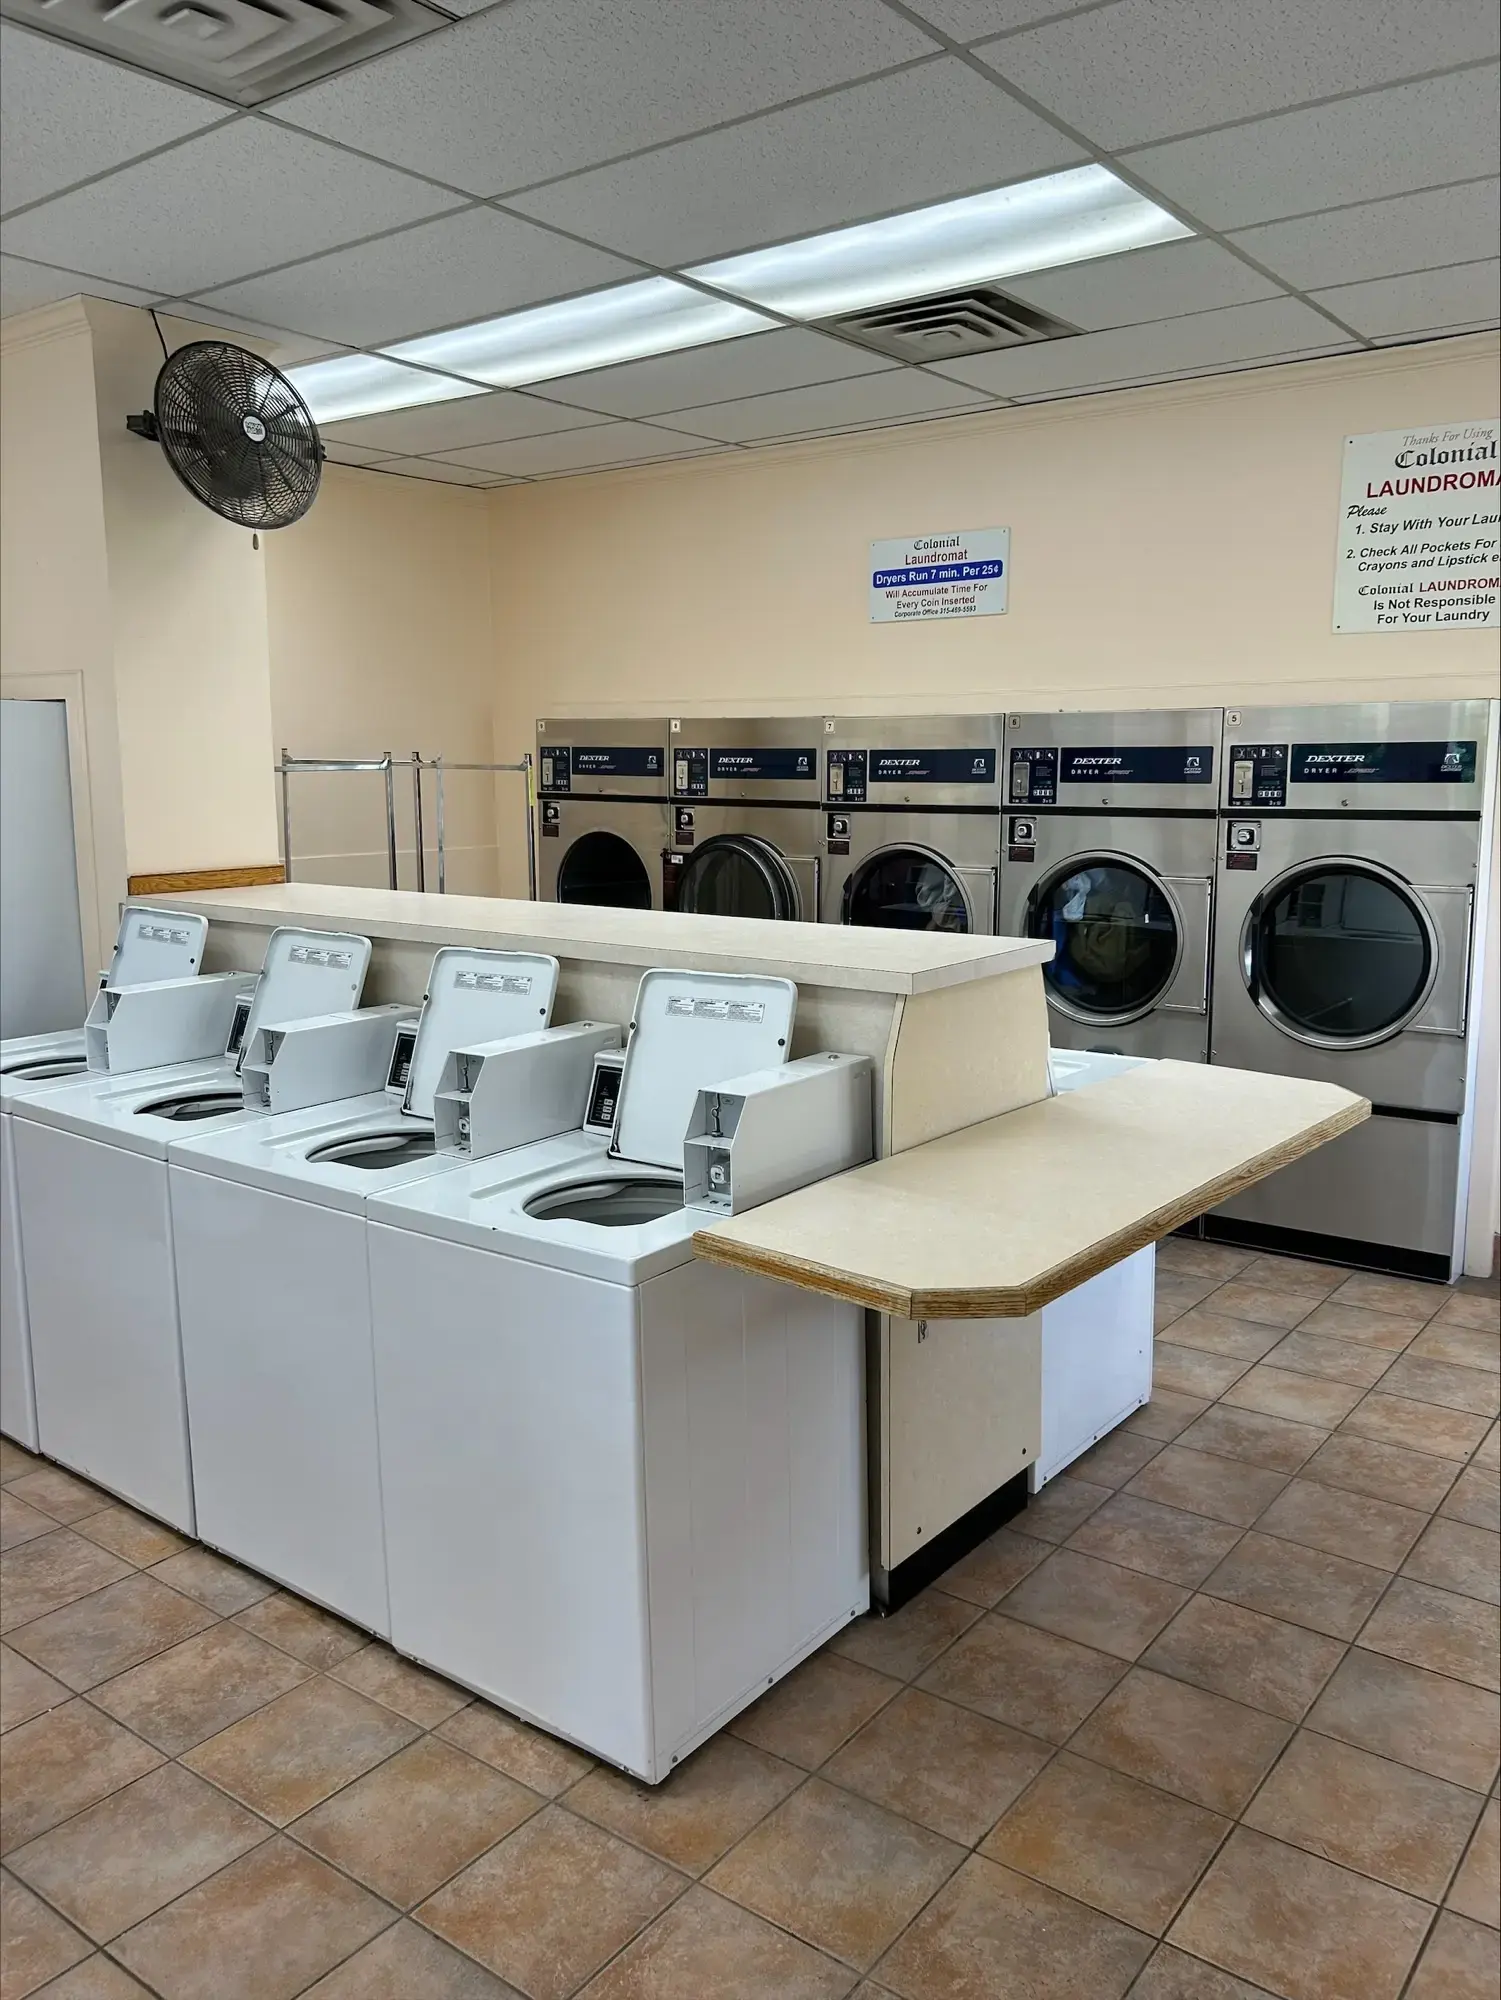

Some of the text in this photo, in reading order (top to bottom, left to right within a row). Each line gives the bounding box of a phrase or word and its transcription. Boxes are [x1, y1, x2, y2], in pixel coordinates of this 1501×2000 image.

[1403, 428, 1494, 447] Thanks For Using
[1395, 440, 1498, 469] Colonial
[1347, 505, 1388, 519] Please
[1355, 524, 1366, 535] 1.
[1369, 522, 1399, 535] Stay
[1402, 518, 1433, 531] With
[1438, 516, 1470, 528] Your
[914, 536, 960, 551] Colonial
[1346, 539, 1497, 559] 2. Check All Pockets For
[905, 549, 968, 566] Laundromat
[1358, 560, 1408, 573] Crayons
[1410, 557, 1435, 568] and
[1437, 553, 1489, 568] Lipstick
[876, 564, 999, 586] Dryers Run 7 min. Per 25¢
[885, 583, 988, 599] Will Accumulate Time For
[1358, 577, 1501, 596] Colonial LAUNDROM
[896, 595, 976, 610] Every Coin Inserted
[1373, 593, 1496, 610] Is Not Responsible
[894, 610, 921, 618] Corporate
[1377, 609, 1490, 624] For Your Laundry
[1231, 714, 1238, 723] 5
[1072, 757, 1122, 765] DEXTER
[1305, 754, 1366, 763] DEXTER
